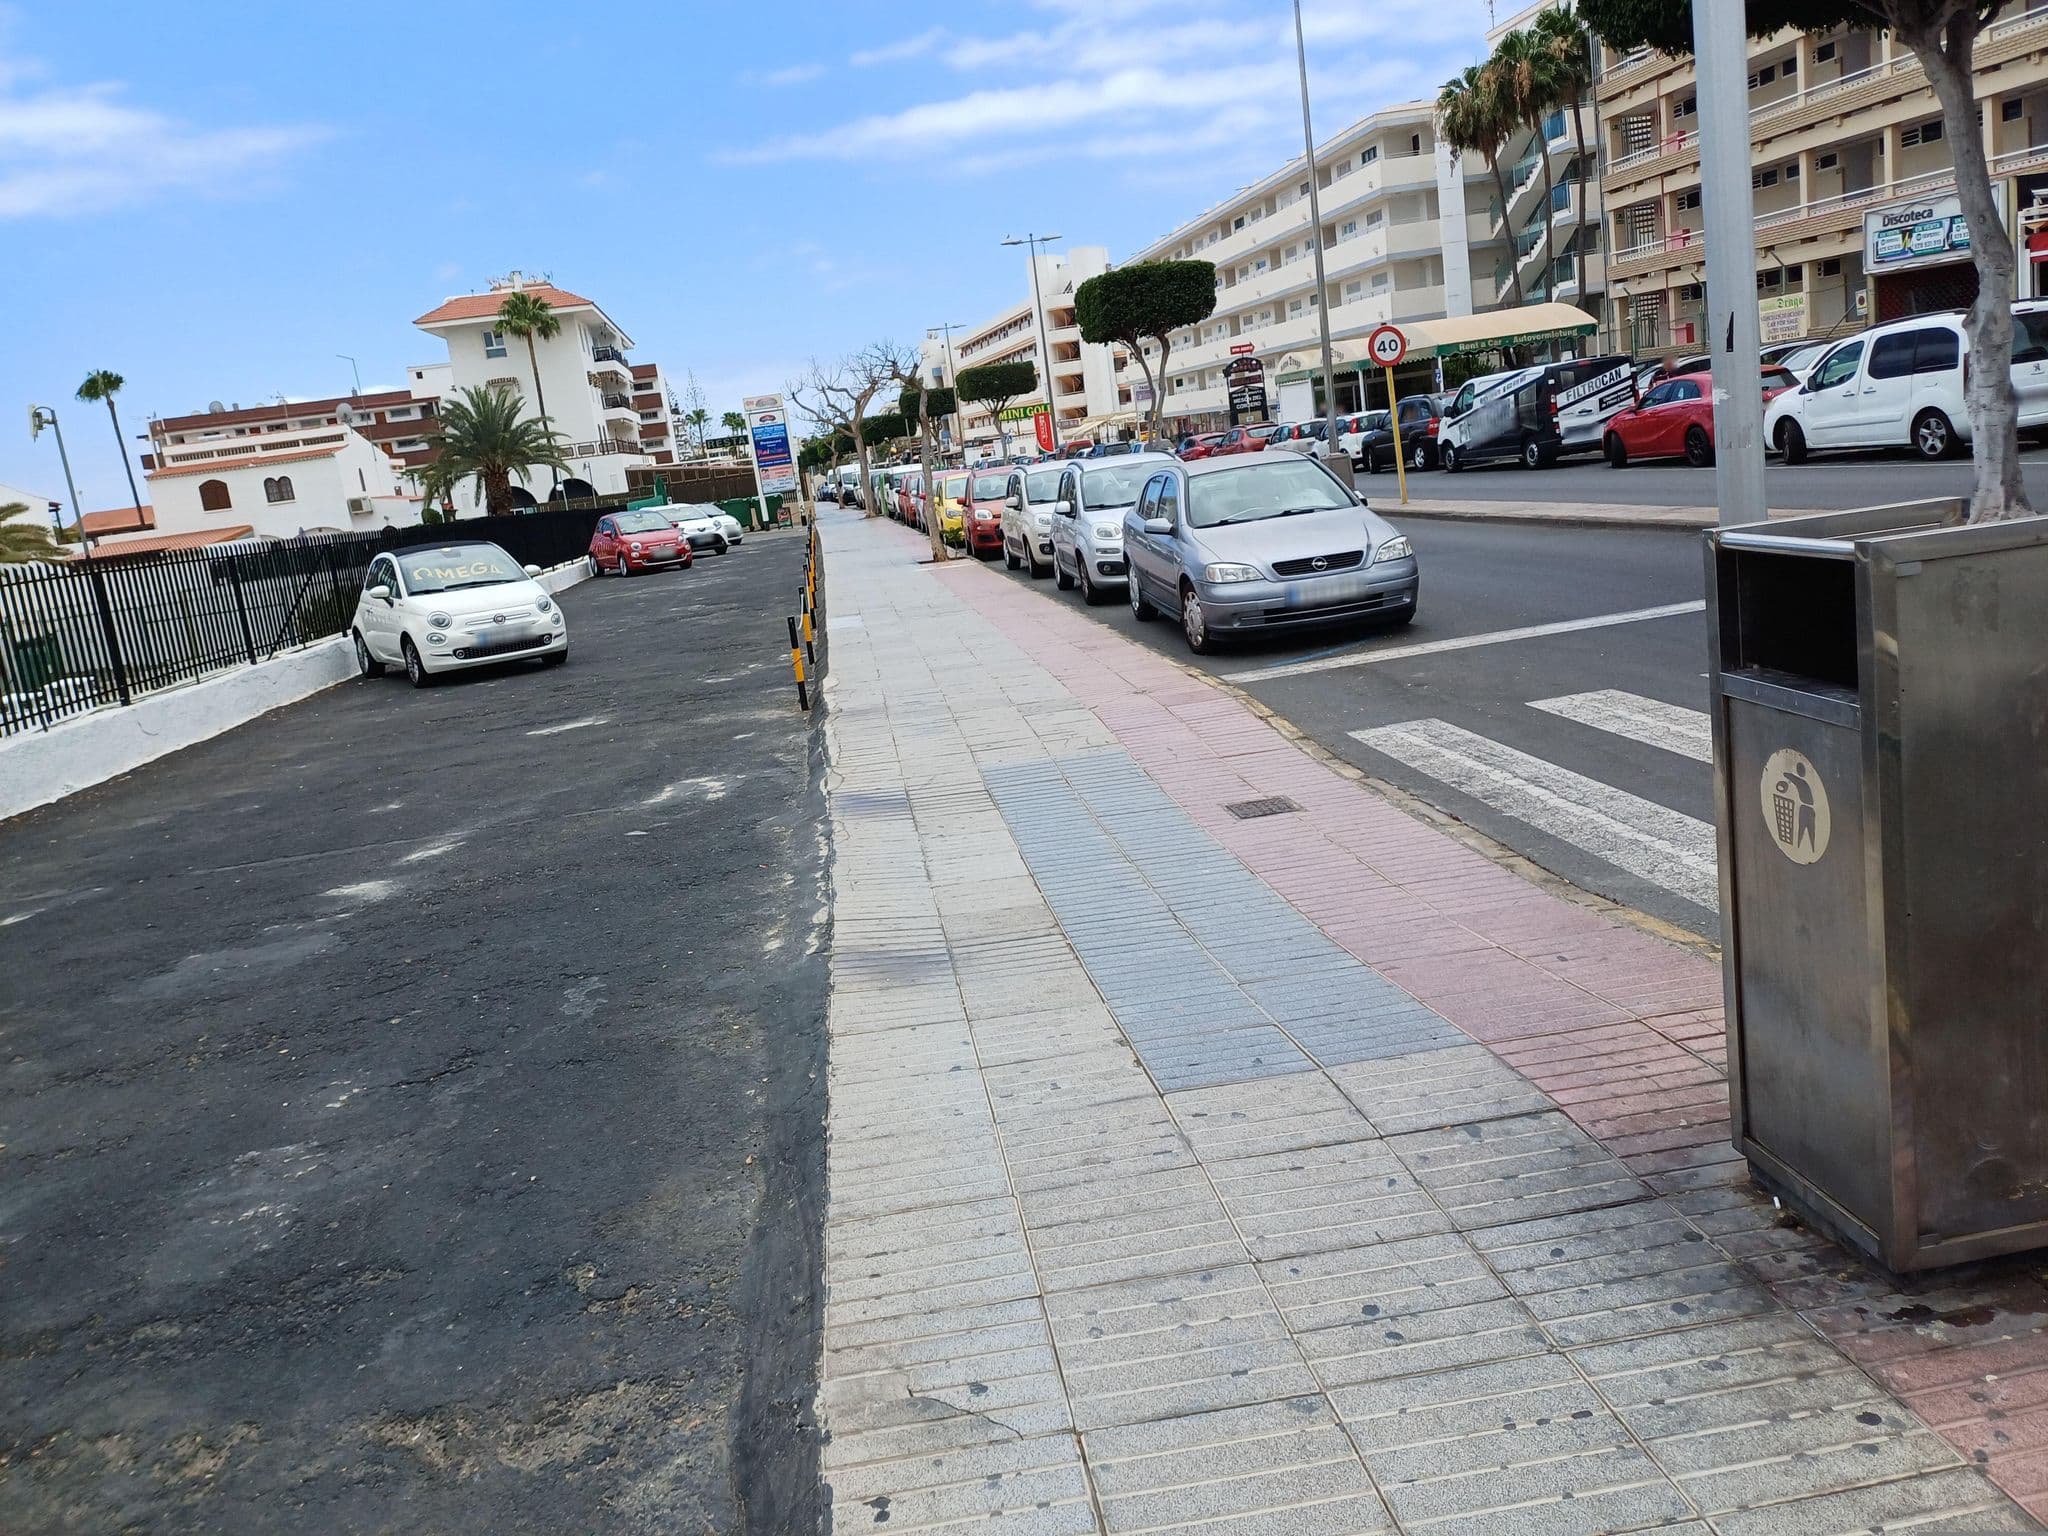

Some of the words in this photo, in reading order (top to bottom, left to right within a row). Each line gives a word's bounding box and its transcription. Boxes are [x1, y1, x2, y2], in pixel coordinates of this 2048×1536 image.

[1882, 208, 1934, 227] Discoteca
[1377, 339, 1398, 353] 40
[1459, 343, 1479, 351] Rent
[1488, 339, 1502, 347] Car
[1513, 327, 1578, 343] Autovermietung
[1566, 367, 1622, 402] FILTROCAN
[999, 407, 1025, 420] MINI
[413, 561, 504, 581] OMEGA
